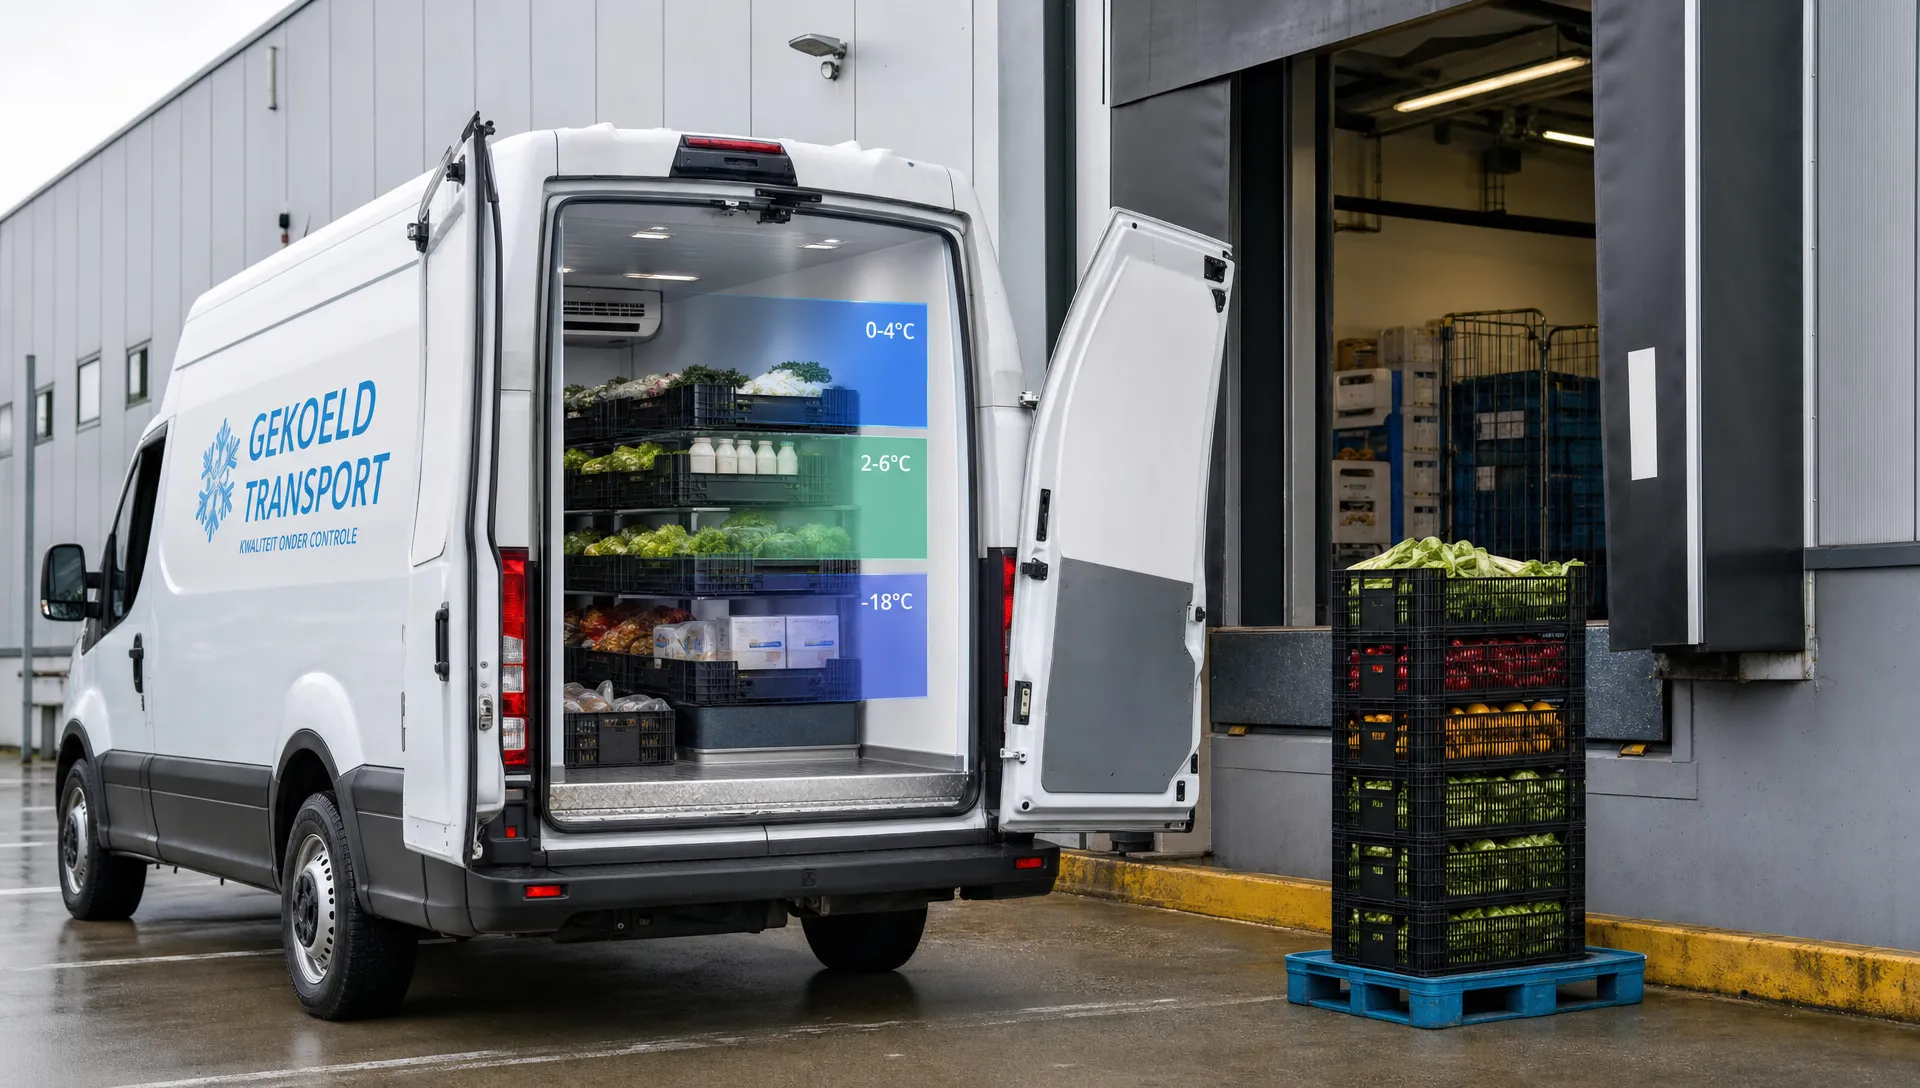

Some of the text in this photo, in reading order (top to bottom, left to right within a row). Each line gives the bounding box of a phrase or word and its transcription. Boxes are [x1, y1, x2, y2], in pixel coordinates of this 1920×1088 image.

[249, 380, 377, 462] GEKOELD
[245, 452, 391, 523] TRANSPORT
[239, 527, 358, 554] KWALITEIT ONDER CONTROLE
